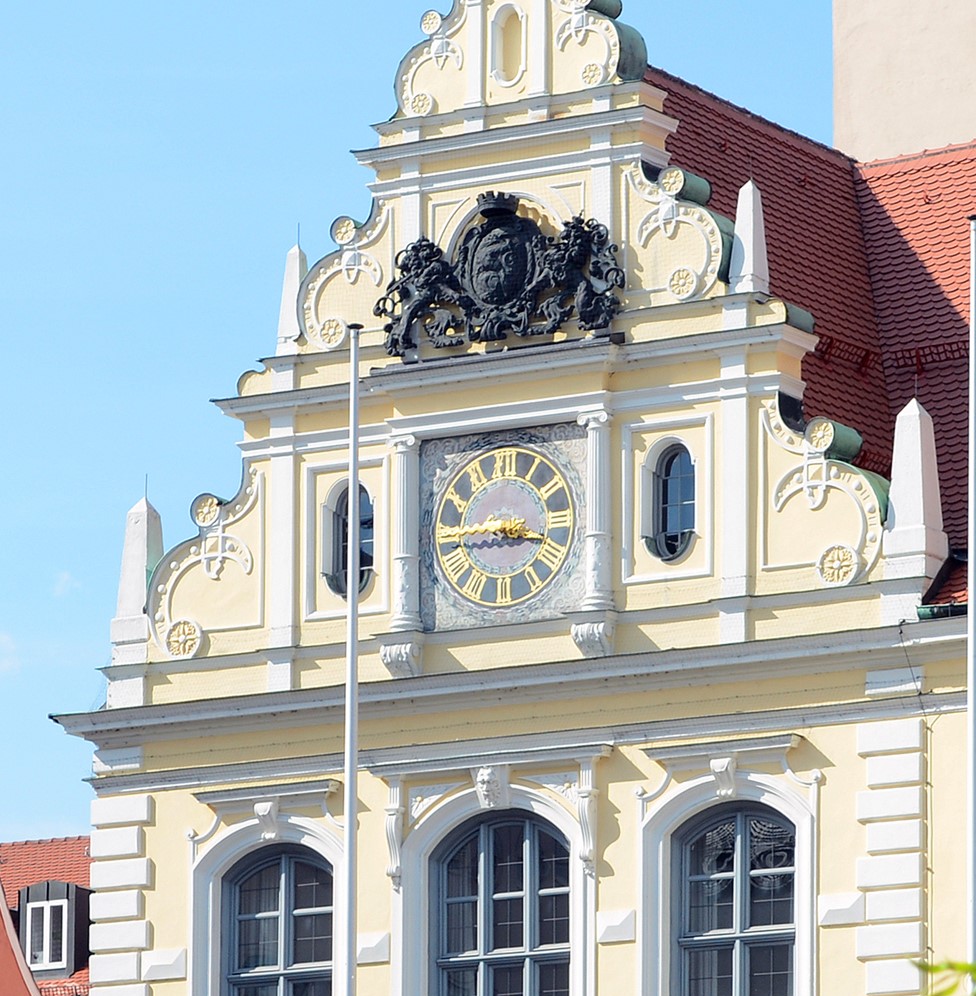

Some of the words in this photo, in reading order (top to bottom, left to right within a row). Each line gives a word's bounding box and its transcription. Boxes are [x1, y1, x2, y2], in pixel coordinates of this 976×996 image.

[466, 461, 487, 492] XI
[492, 451, 517, 478] XII
[526, 456, 542, 481] I
[446, 487, 467, 513] X
[540, 474, 564, 500] II
[548, 509, 570, 530] III
[538, 537, 566, 571] IIII
